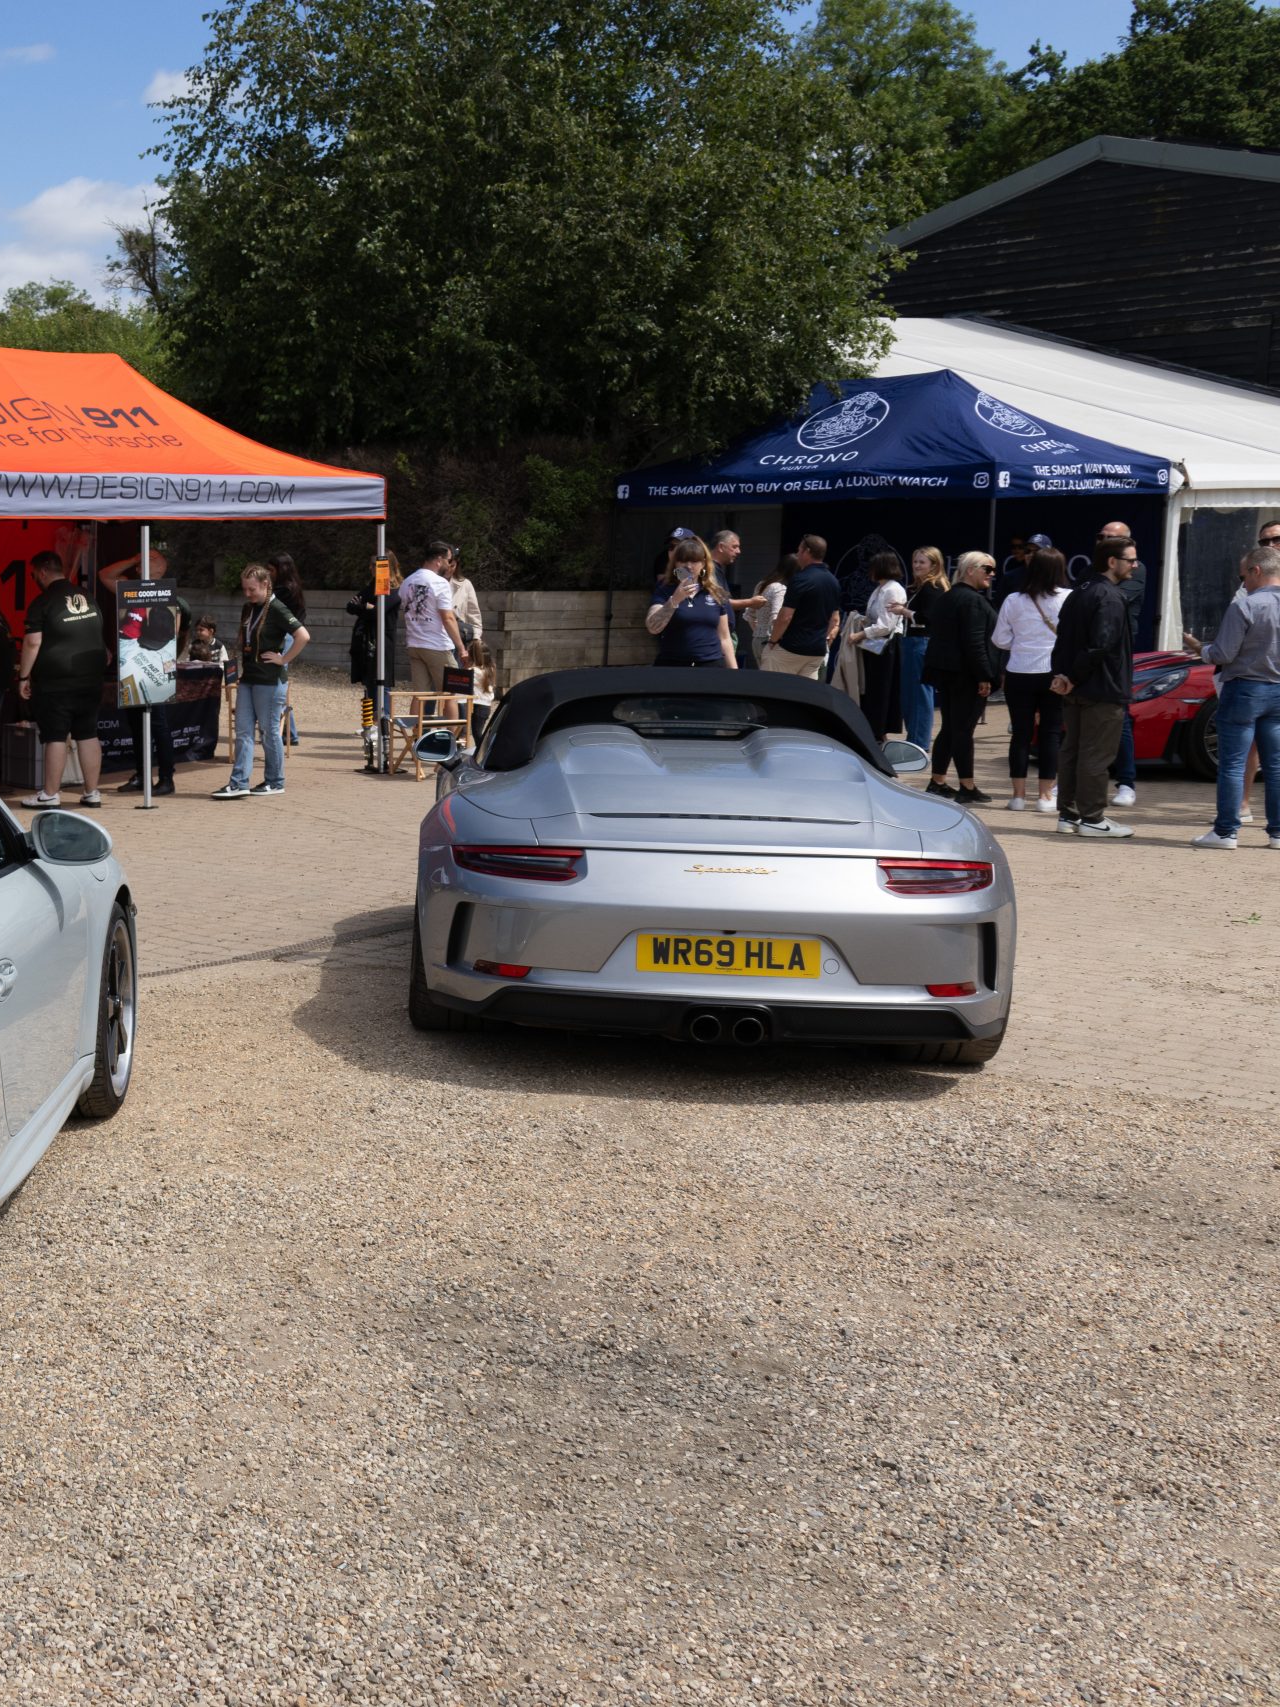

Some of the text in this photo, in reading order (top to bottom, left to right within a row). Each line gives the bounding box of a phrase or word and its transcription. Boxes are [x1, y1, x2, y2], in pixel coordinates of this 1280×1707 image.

[81, 406, 160, 429] 911
[28, 426, 71, 445] for
[69, 427, 183, 448] Porsche
[759, 451, 859, 465] CHRONO
[1033, 463, 1132, 476] THE SMART WAY TO BUY
[648, 475, 949, 496] THE SMART WAY TO BUY OR SELL A LUXURY WATCH
[1032, 480, 1046, 491] OR
[1046, 480, 1067, 490] SELL
[1076, 479, 1105, 490] LUXURY
[1106, 478, 1139, 489] WATCH
[158, 589, 172, 597] BAGS
[652, 937, 806, 971] WR69 HLA
